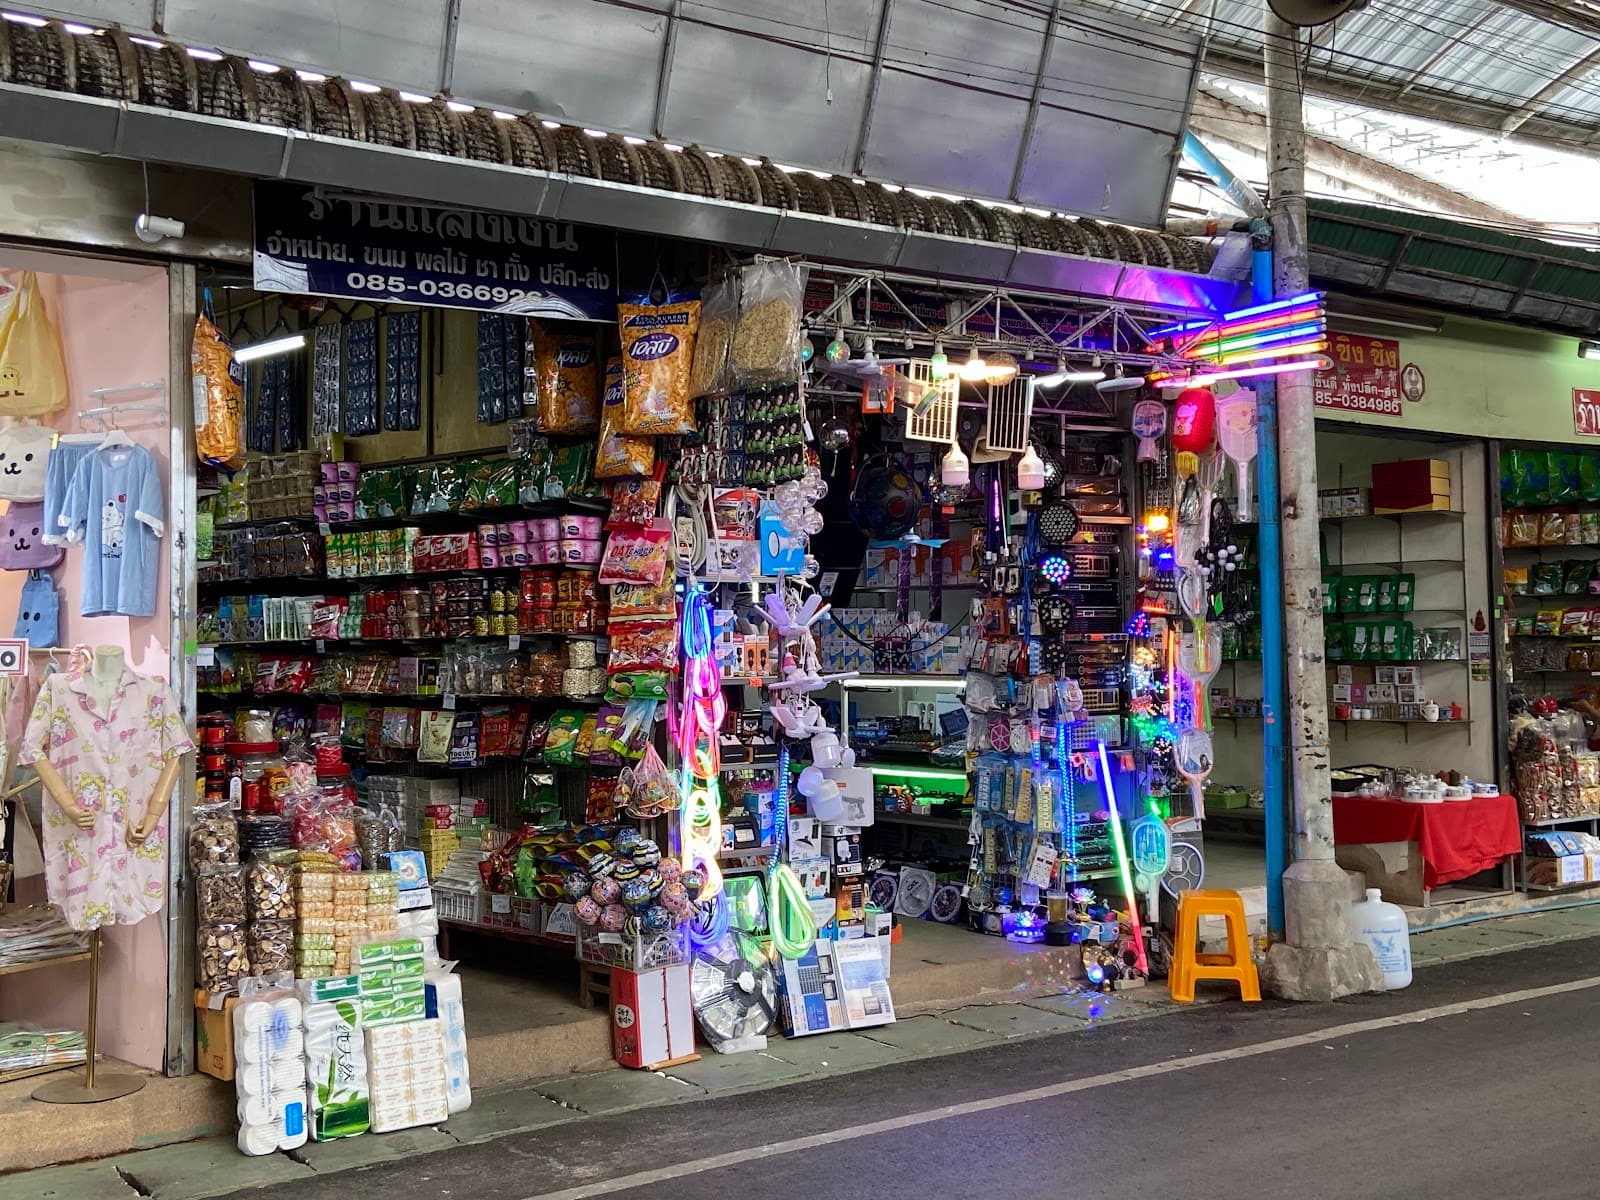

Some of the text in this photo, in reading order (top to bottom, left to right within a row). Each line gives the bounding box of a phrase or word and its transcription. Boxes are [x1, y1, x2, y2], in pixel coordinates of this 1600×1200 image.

[363, 245, 407, 269] ขนม
[476, 258, 498, 279] ชา
[504, 252, 530, 282] ทั้ง
[611, 544, 633, 558] OAT
